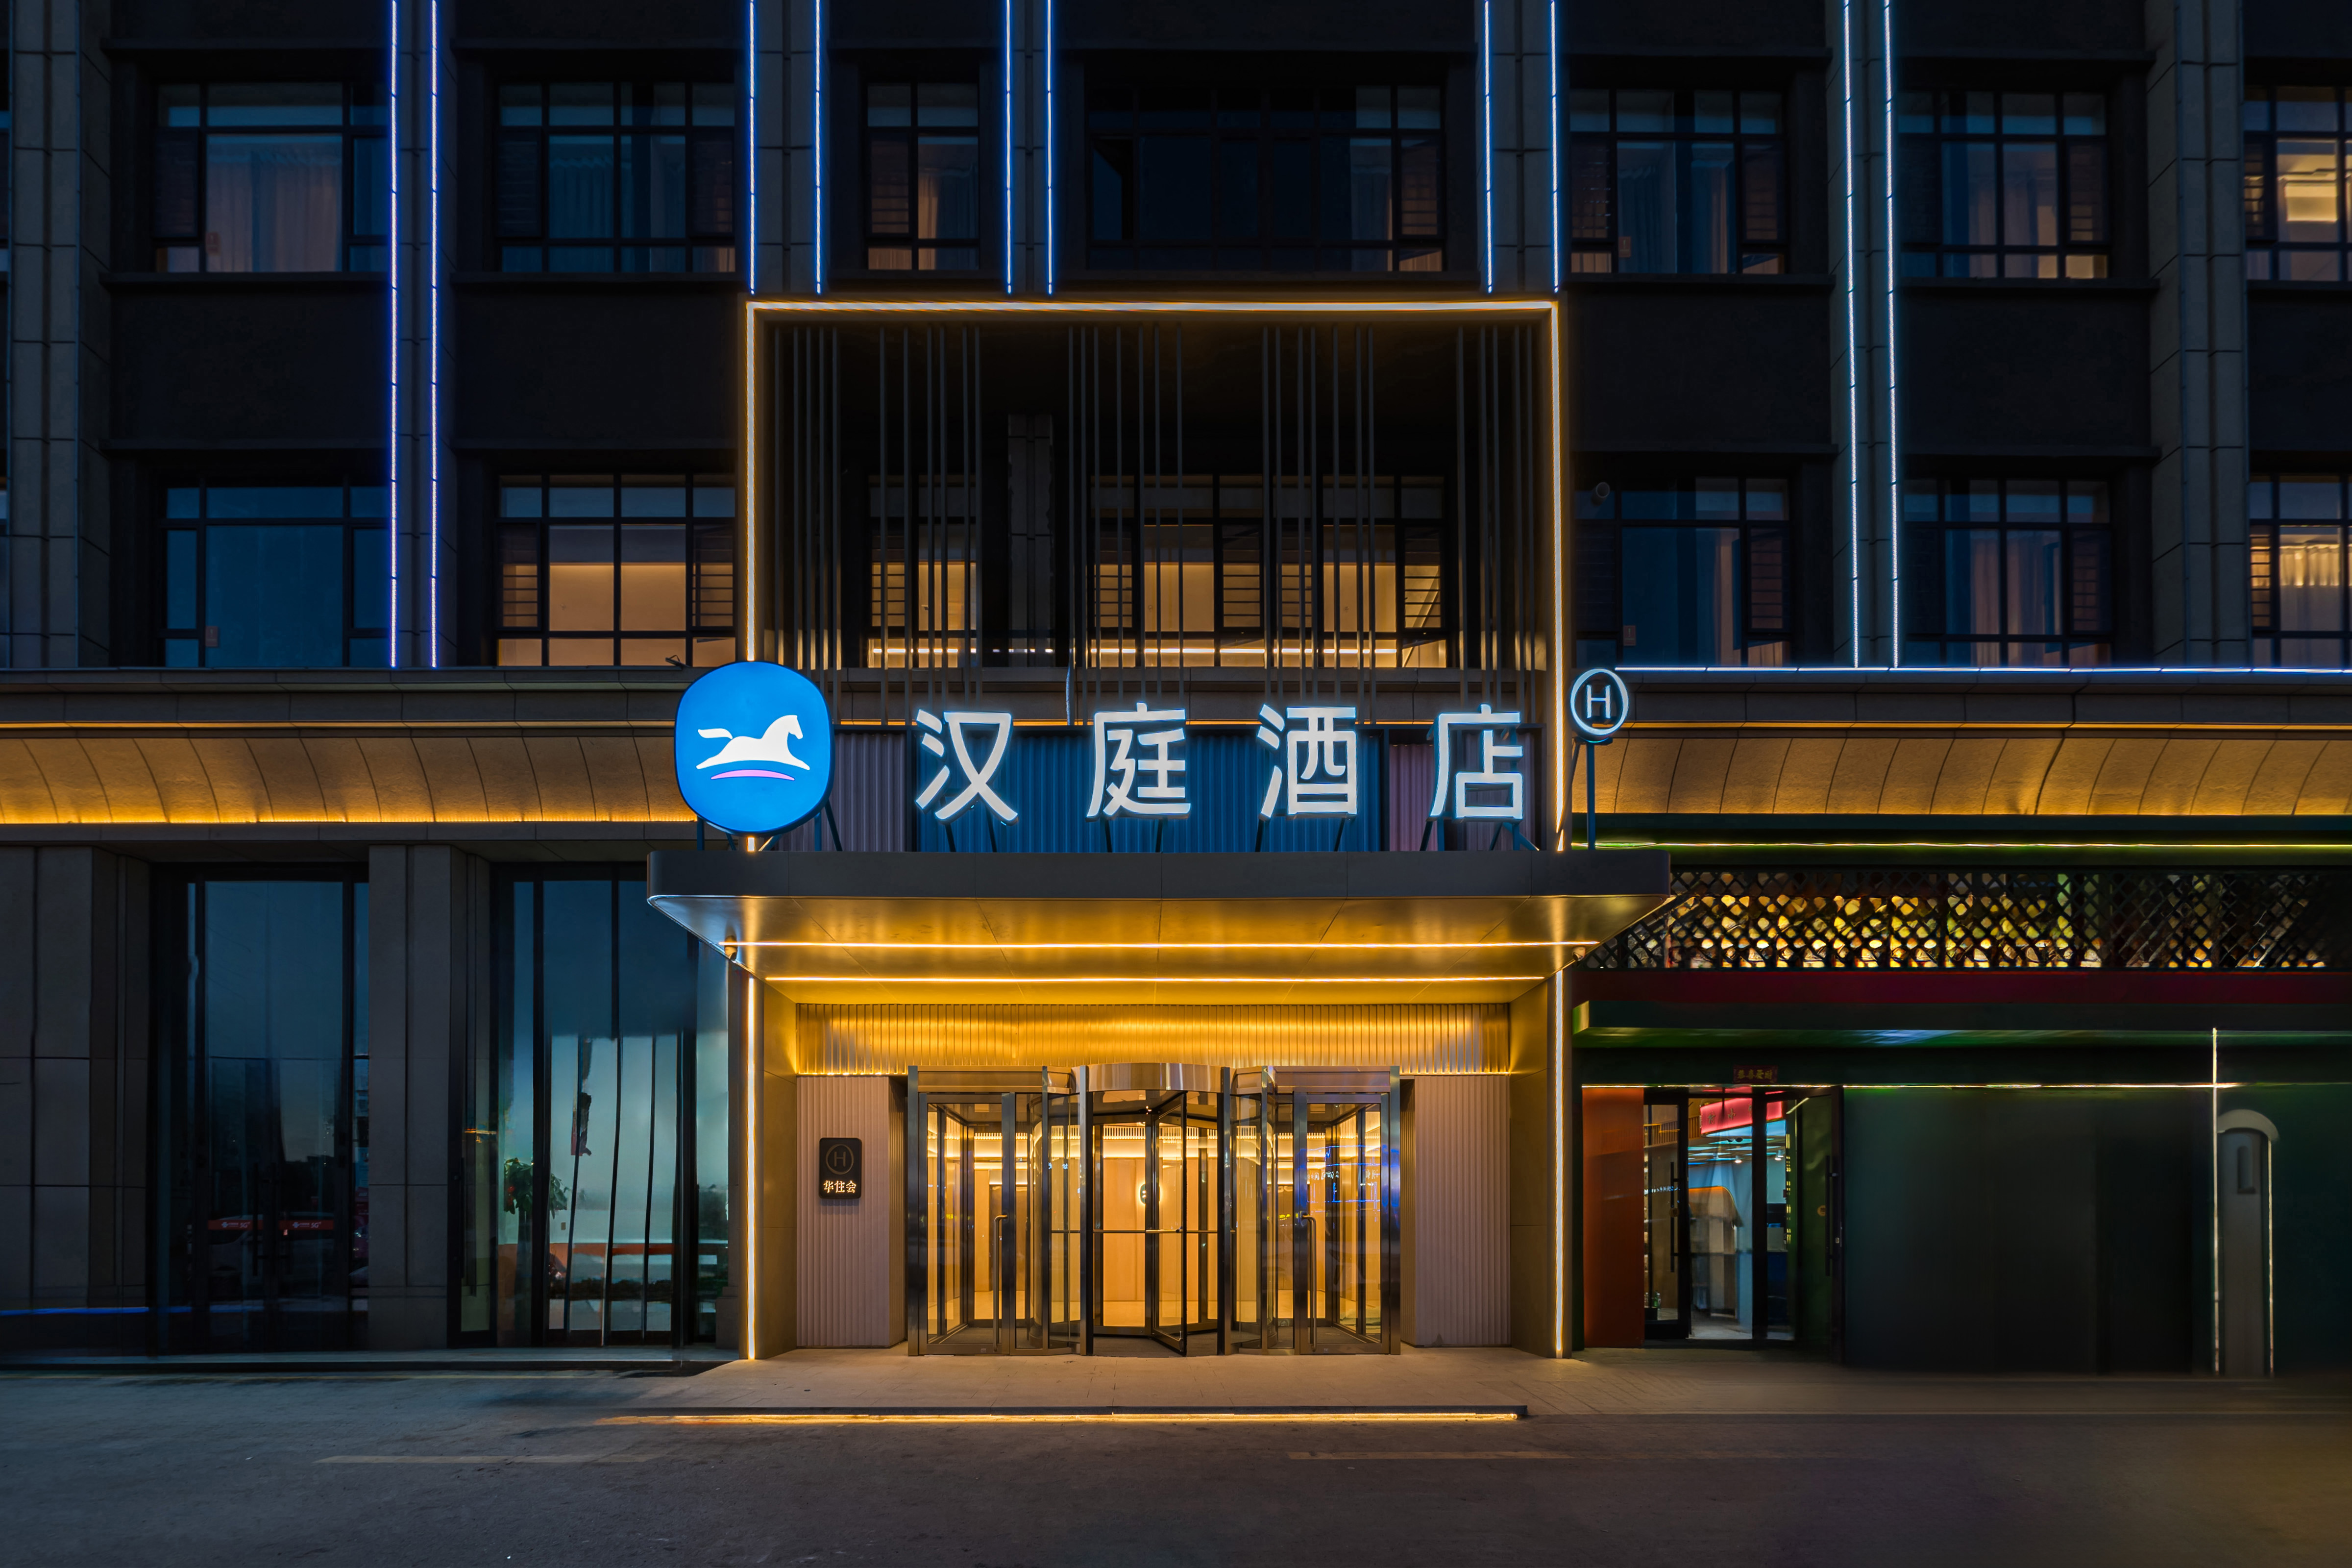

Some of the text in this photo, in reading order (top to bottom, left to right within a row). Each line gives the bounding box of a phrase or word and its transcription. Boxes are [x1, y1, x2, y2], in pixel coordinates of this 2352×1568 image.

[915, 703, 1523, 821] 汉庭酒店
[823, 1180, 857, 1193] 华住会
